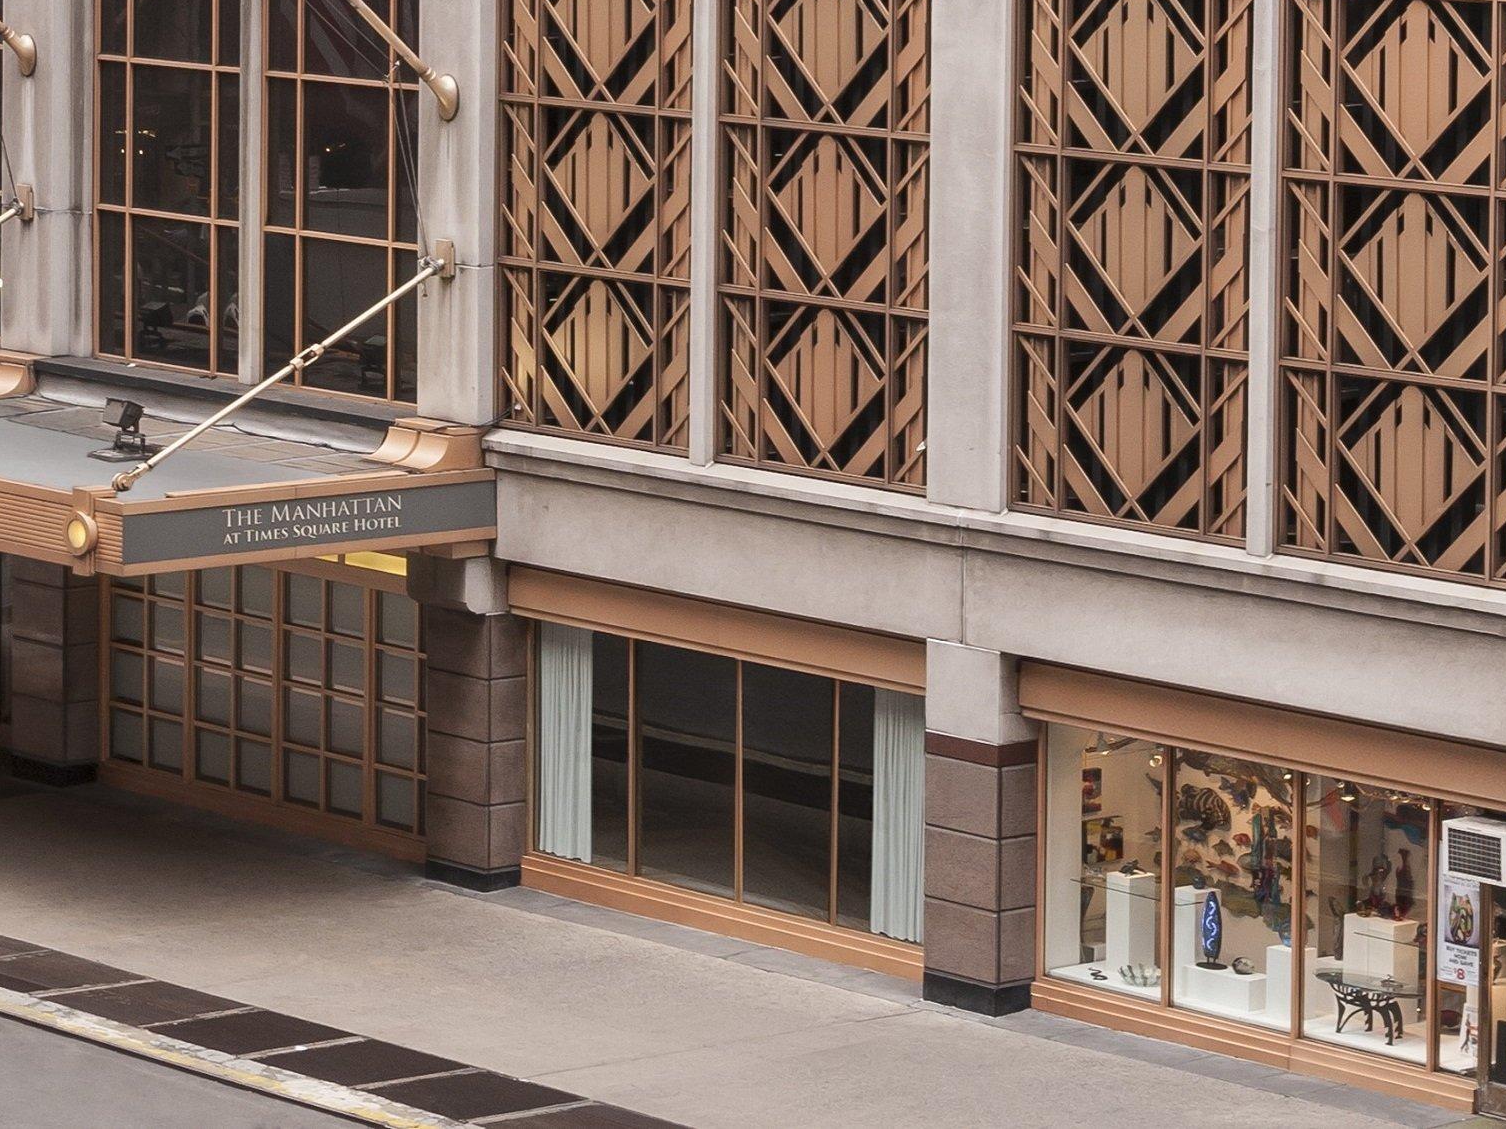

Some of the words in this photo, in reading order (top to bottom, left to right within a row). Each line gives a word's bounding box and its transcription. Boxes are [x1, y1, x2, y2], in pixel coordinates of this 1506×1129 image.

[222, 508, 263, 528] THE
[271, 494, 402, 523] MANHATTAN
[223, 532, 241, 545] AT
[244, 527, 289, 543] TIMES
[293, 521, 349, 539] SQUARE
[354, 516, 402, 532] HOTEL
